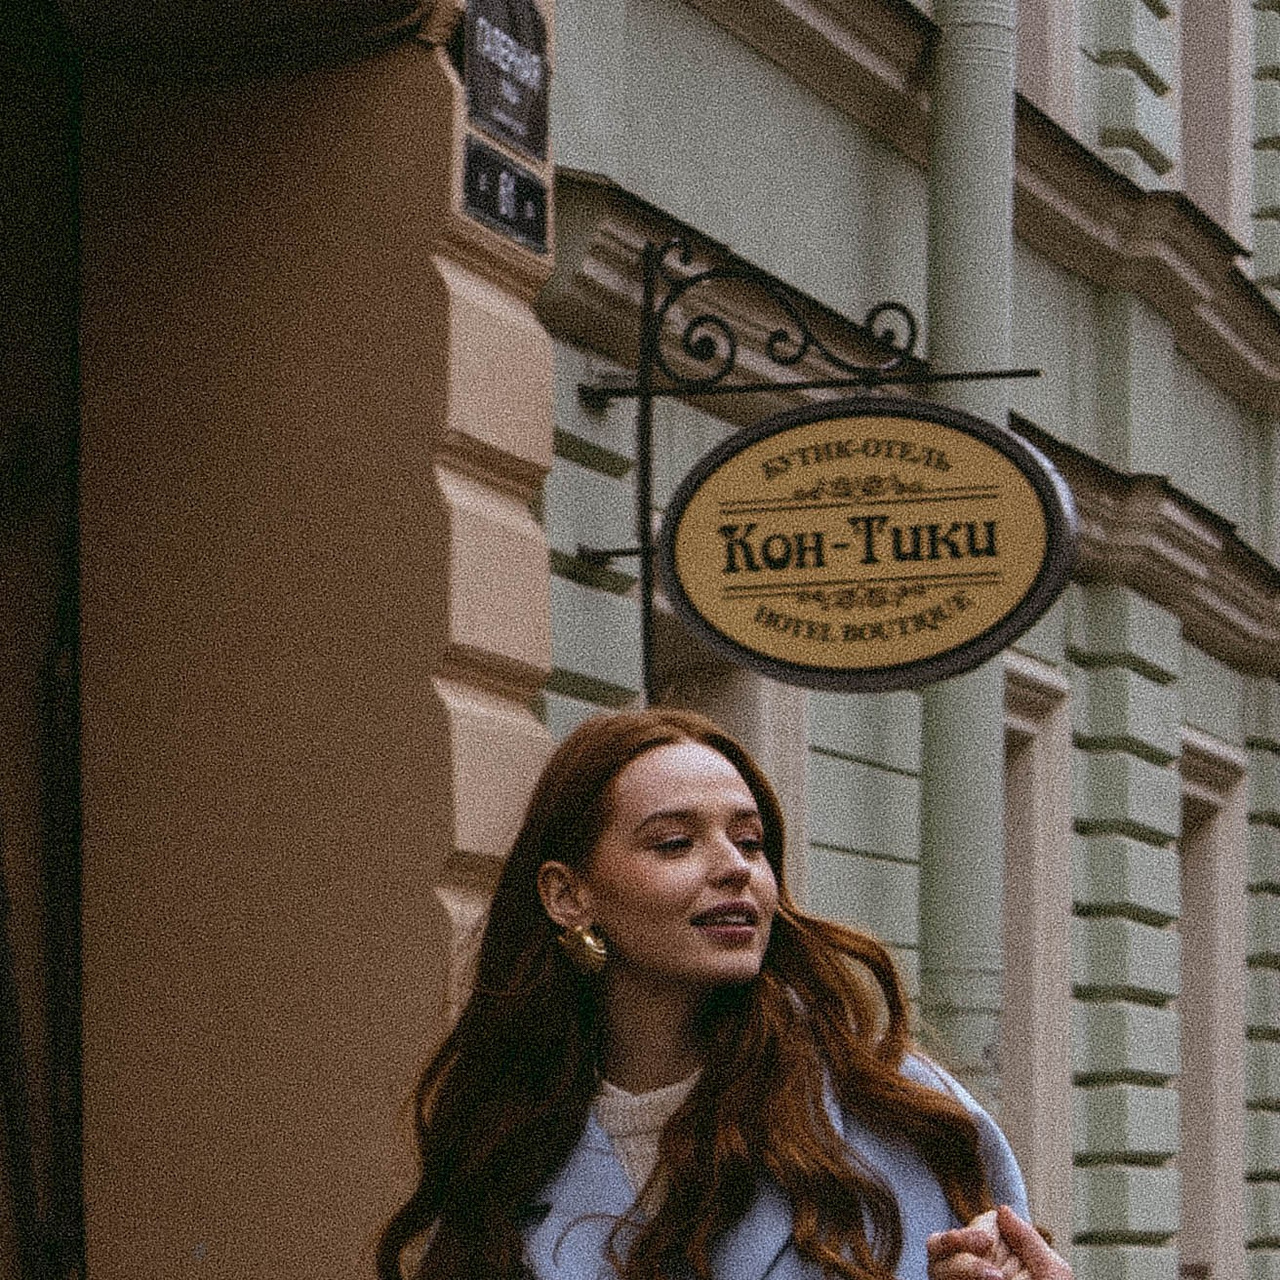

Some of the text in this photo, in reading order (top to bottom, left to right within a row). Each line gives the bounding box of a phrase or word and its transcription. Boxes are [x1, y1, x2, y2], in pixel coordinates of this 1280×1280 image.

[760, 438, 952, 480] БУТИК-ОТЕЛЬ
[718, 514, 997, 575] Кон-Тики
[754, 591, 972, 643] HOTEL BOUTIQUE
